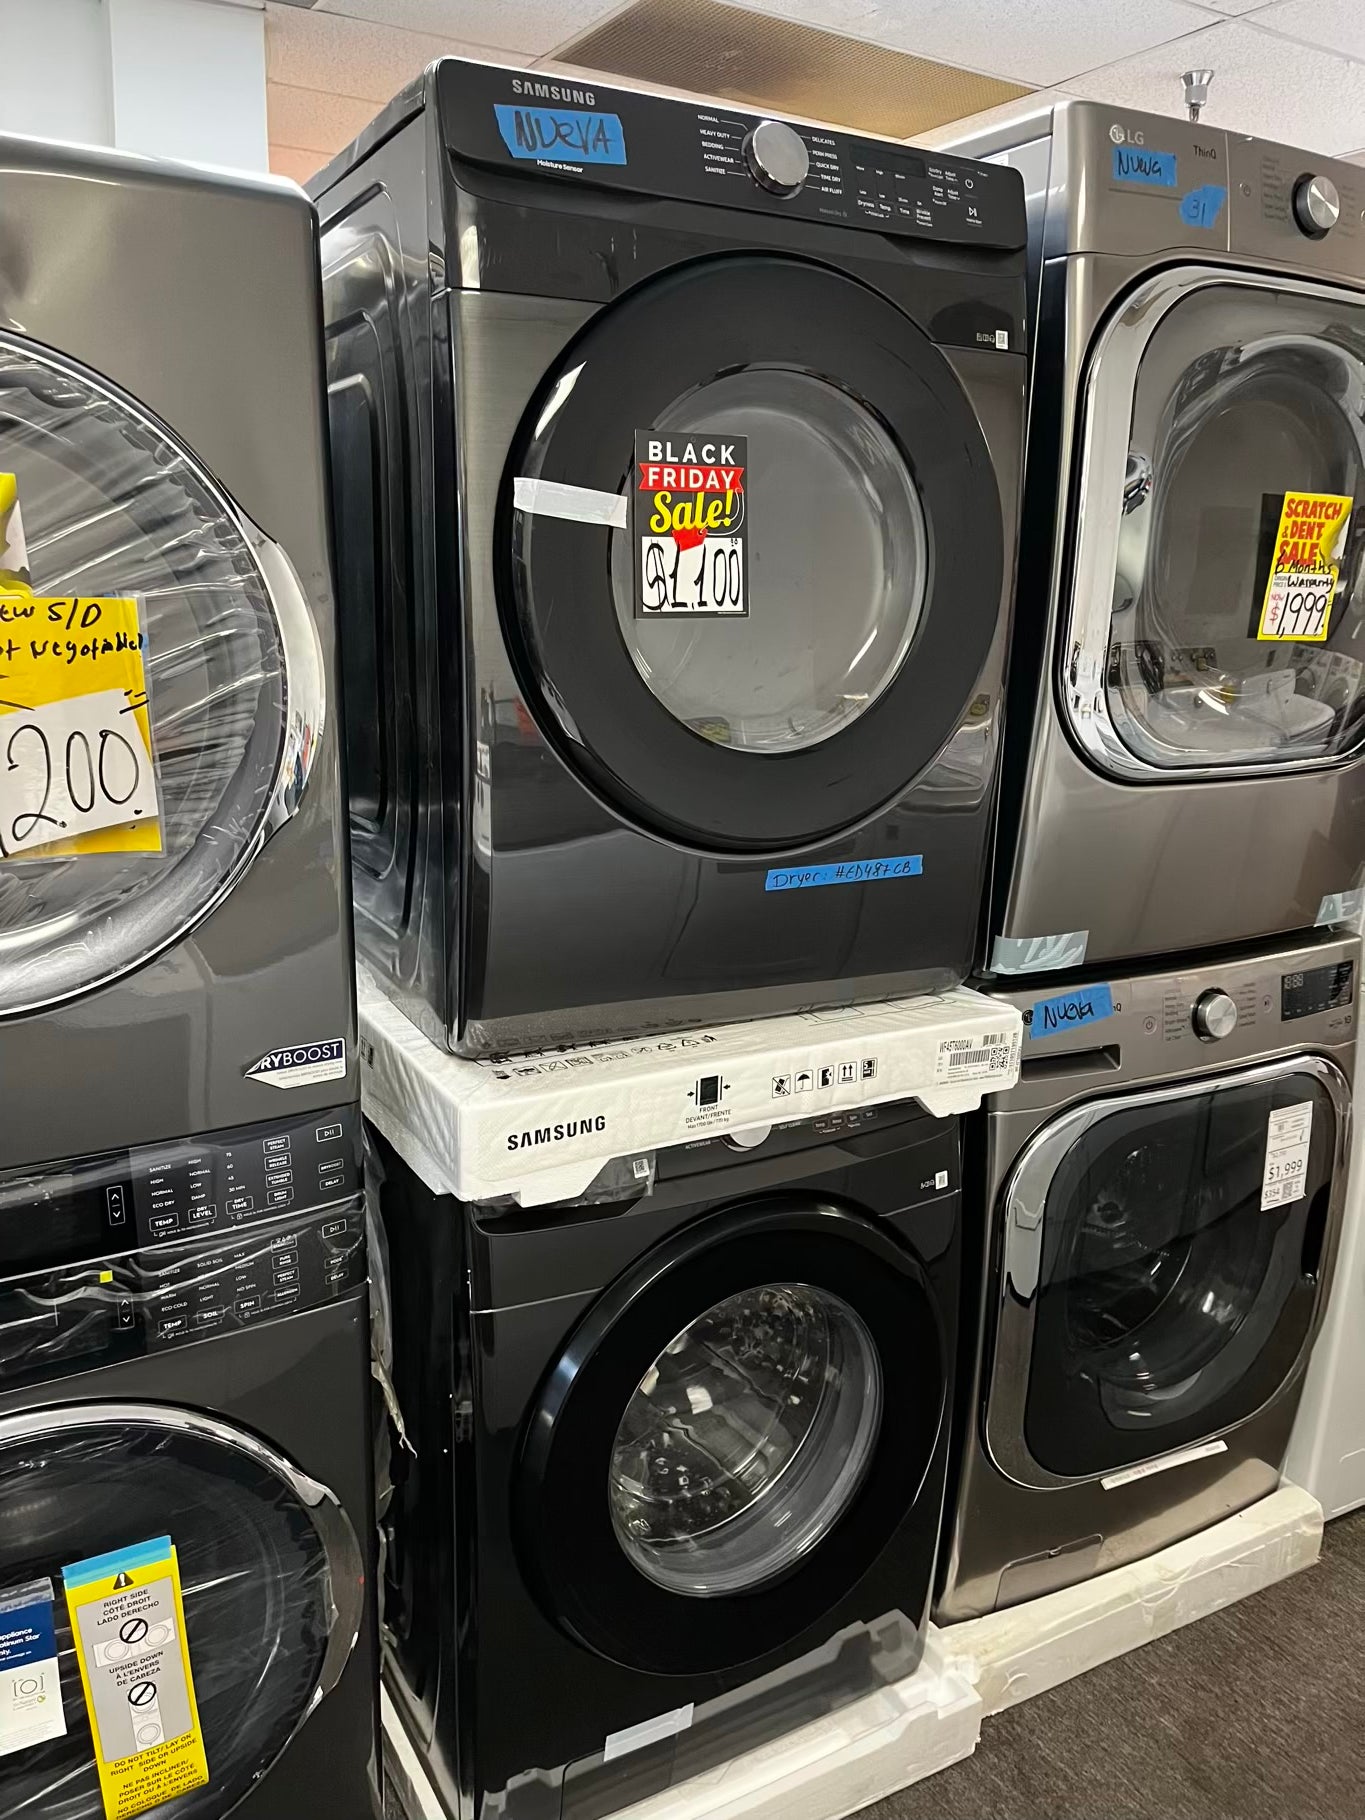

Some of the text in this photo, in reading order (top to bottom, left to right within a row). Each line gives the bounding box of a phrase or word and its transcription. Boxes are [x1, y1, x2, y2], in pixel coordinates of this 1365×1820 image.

[512, 79, 596, 106] SAMSUNG
[697, 114, 720, 124] NORMAL
[699, 128, 731, 140] HEAVY DUTY
[1126, 129, 1144, 145] LG
[701, 140, 724, 150] BEDDING
[811, 136, 836, 146] DELICATES
[1193, 144, 1217, 160] ThinQ
[703, 153, 735, 164] ACTIVEWEAR
[563, 163, 584, 173] Sensor
[704, 165, 726, 176] SANITIZE
[815, 161, 840, 172] QUICK DRY
[820, 173, 842, 183] TIME DRY
[648, 440, 736, 465] BLACK
[648, 467, 735, 489] FRIDAY
[650, 489, 734, 534] Sale!
[1285, 498, 1343, 521] SCRATCH
[1281, 520, 1326, 541] & DENT
[1279, 540, 1320, 565] SALE
[699, 1104, 719, 1113] FRONT
[685, 1109, 732, 1124] DEVANT/FRENTE
[507, 1115, 607, 1151] SAMSUNG
[149, 1163, 172, 1173] SANITIZE
[189, 1168, 211, 1177] NORMAL
[324, 1178, 340, 1186] DELAY
[151, 1188, 174, 1197] NORMAL
[191, 1193, 206, 1201] DAMP
[231, 1201, 248, 1210] TIME
[192, 1209, 213, 1219] LEVEL
[154, 1217, 174, 1228] TEMP
[198, 1282, 220, 1291] NORMAL
[200, 1294, 214, 1302] LIGHT
[173, 1301, 188, 1309] COLD
[239, 1300, 255, 1309] SPIN
[203, 1310, 218, 1319] SOIL
[163, 1319, 182, 1329] TEMP
[103, 1589, 149, 1608] RIGHT SIDE
[127, 1595, 152, 1609] DROIT
[97, 1600, 160, 1626] LADO DERECHO
[25, 1633, 41, 1642] Star
[109, 1650, 164, 1674] UPSIDE DOWN
[123, 1660, 160, 1678] L'ENVERS
[116, 1667, 161, 1687] DE CABEZA
[110, 1738, 198, 1776] RIGHT SIDE OR UPSIDE
[114, 1760, 126, 1768] DO
[127, 1755, 143, 1764] NOT
[166, 1740, 179, 1749] LAY
[181, 1734, 192, 1742] ON
[143, 1760, 167, 1772] DOWN
[119, 1785, 145, 1798] POSER
[146, 1777, 162, 1787] SUR
[123, 1782, 134, 1790] NE
[135, 1775, 150, 1784] PAS
[117, 1807, 129, 1815] NO
[171, 1784, 181, 1792] DE
[183, 1775, 204, 1787] LADO
[118, 1793, 142, 1805] DROIT
[143, 1787, 155, 1795] OU
